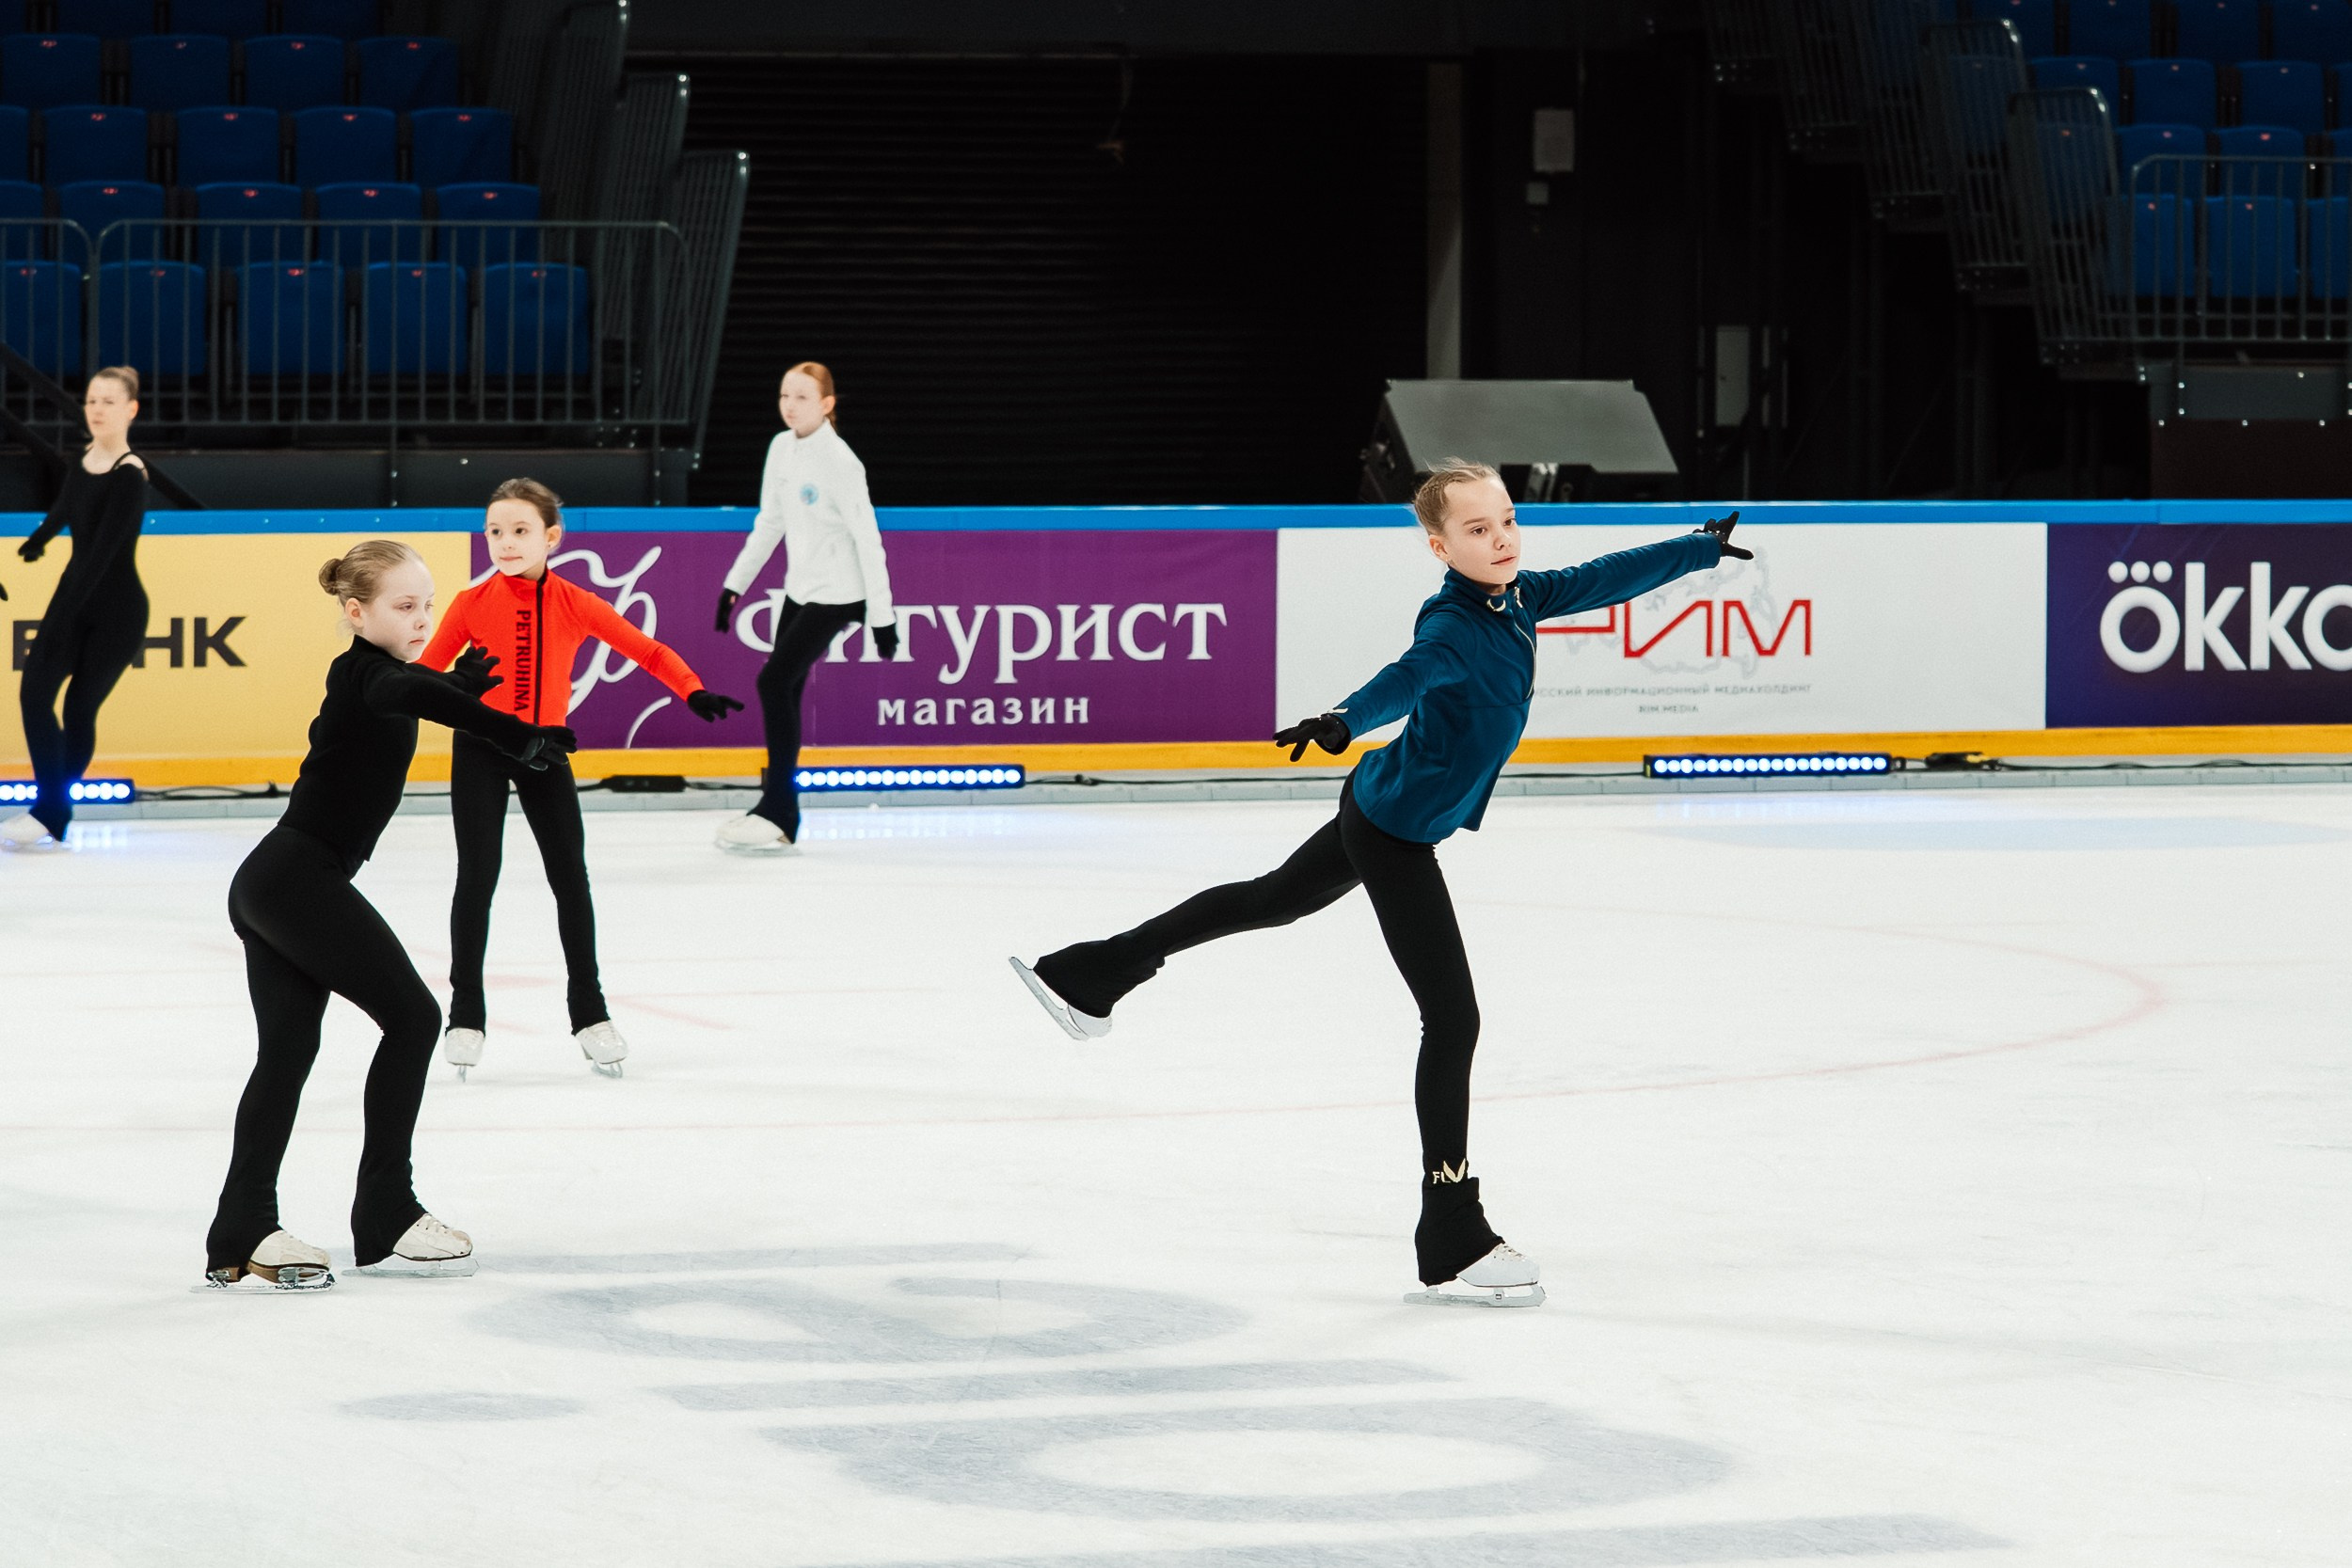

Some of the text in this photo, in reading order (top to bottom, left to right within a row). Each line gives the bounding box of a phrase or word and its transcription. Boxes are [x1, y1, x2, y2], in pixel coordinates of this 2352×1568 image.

[515, 610, 532, 711] PETRUHINA
[1534, 686, 1581, 697] УССКИЙ
[878, 697, 1089, 725] магазин
